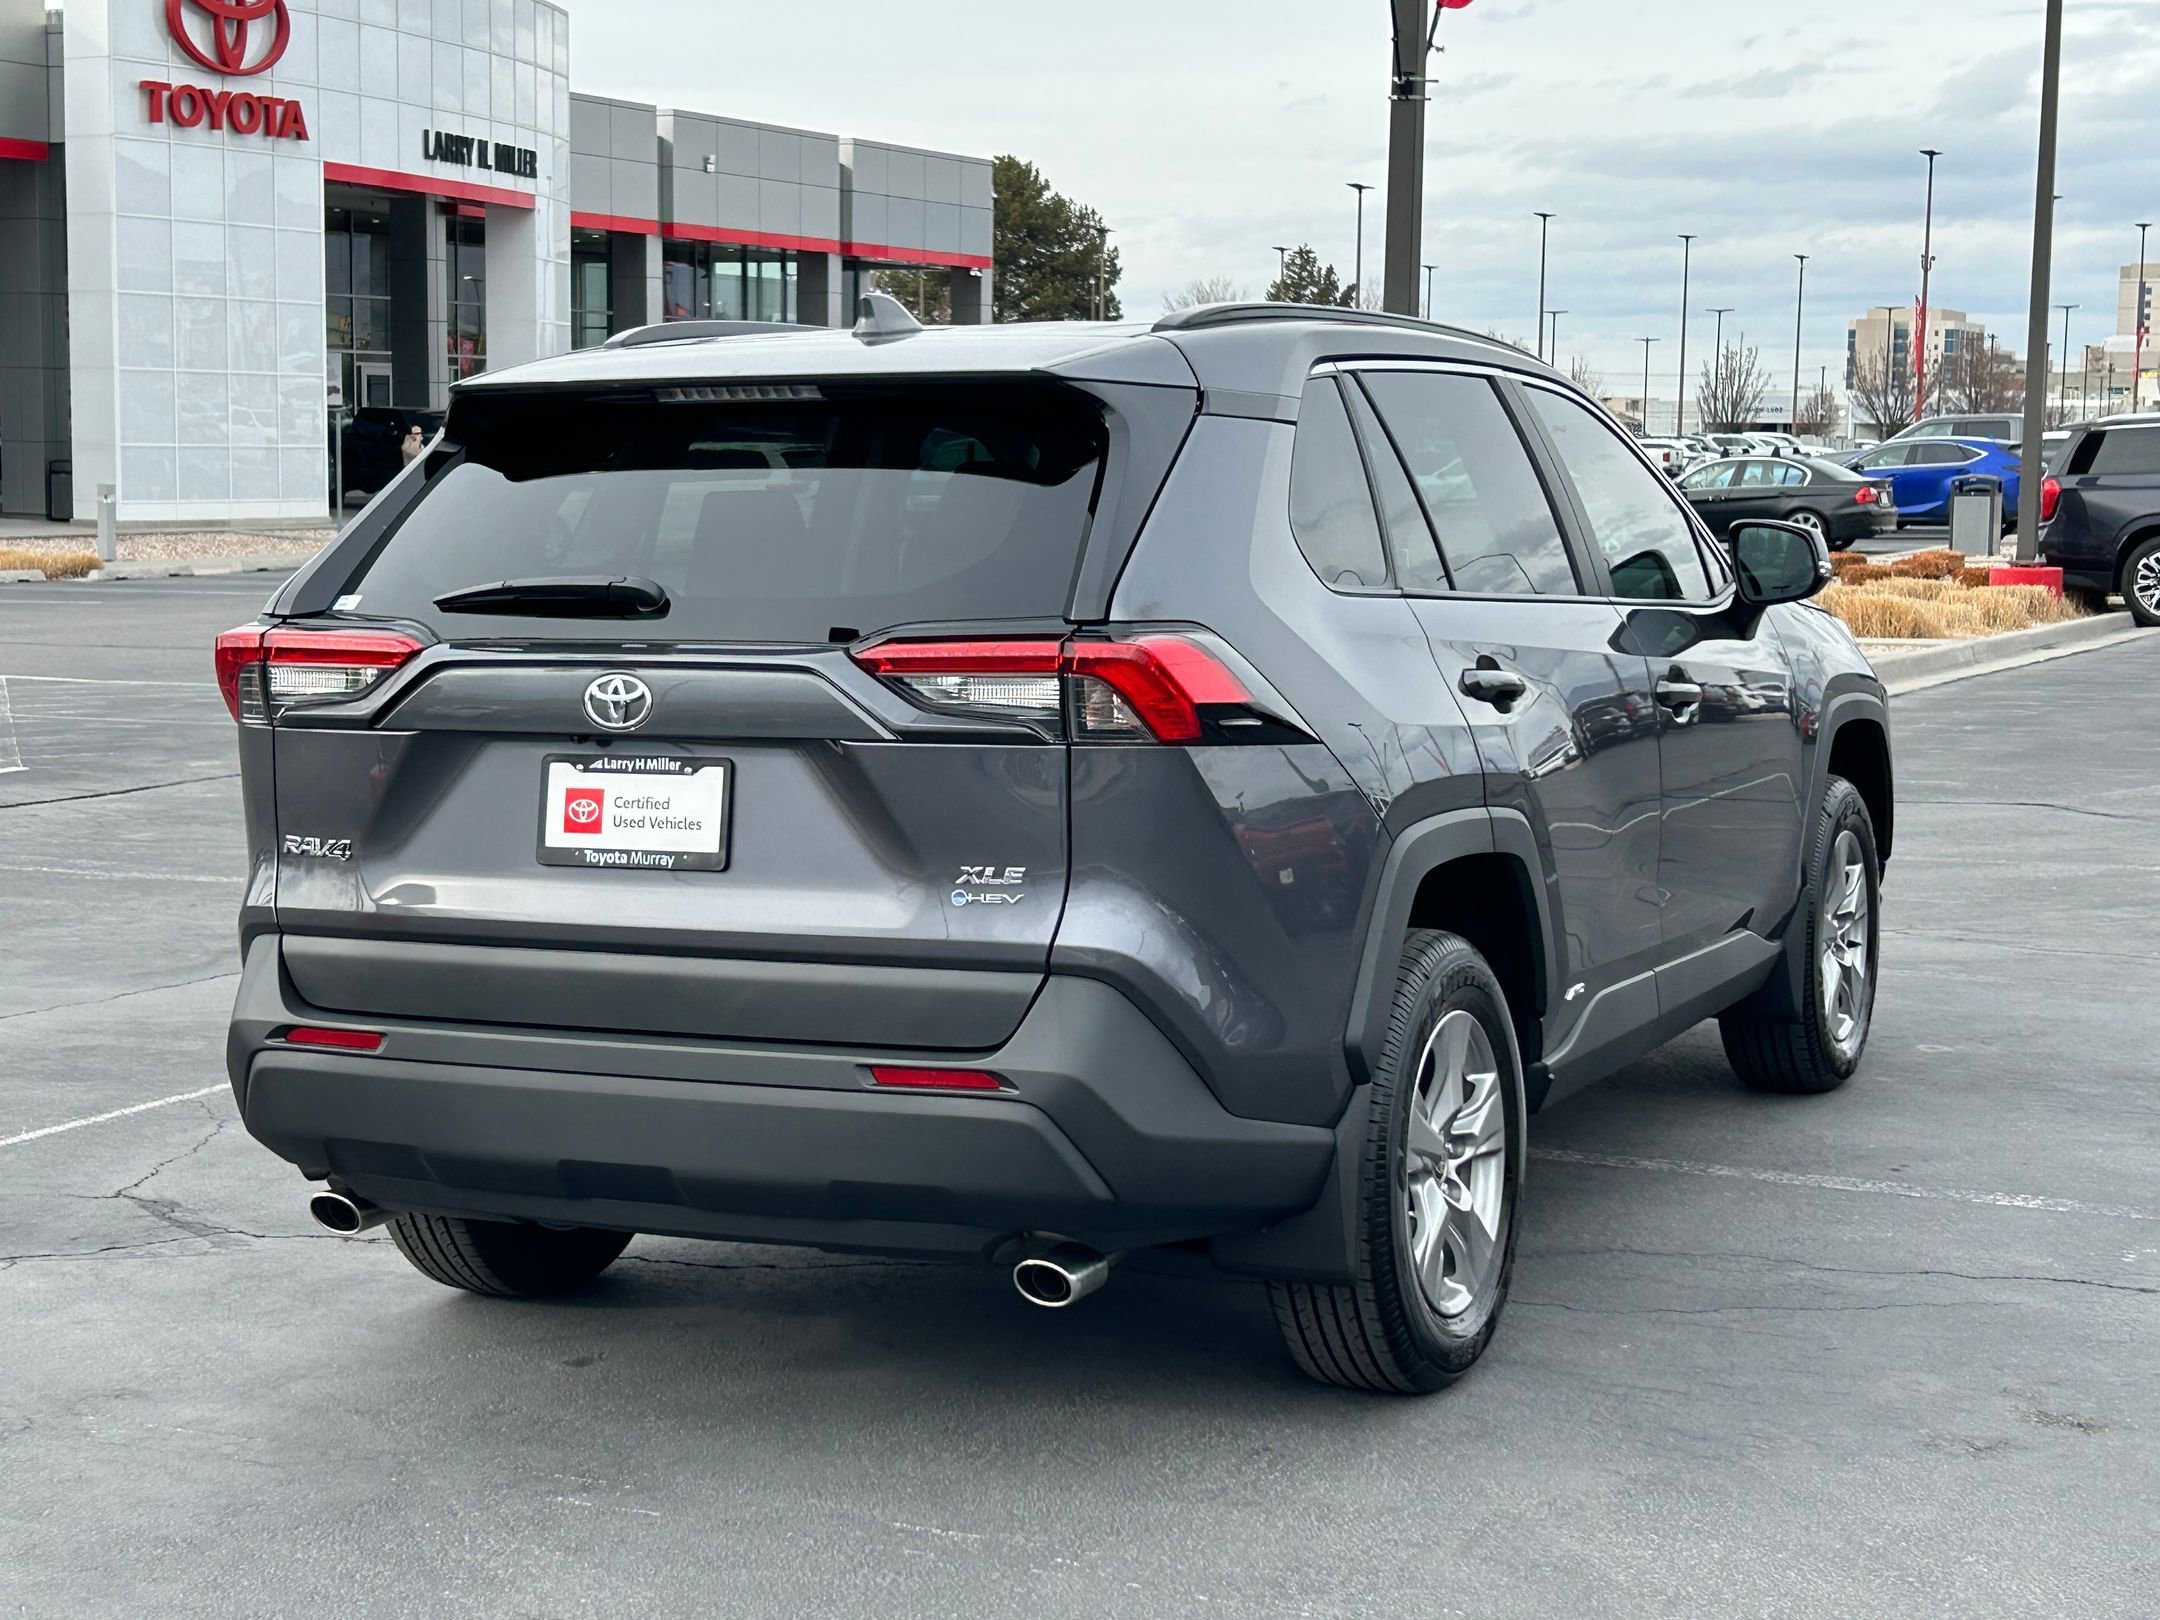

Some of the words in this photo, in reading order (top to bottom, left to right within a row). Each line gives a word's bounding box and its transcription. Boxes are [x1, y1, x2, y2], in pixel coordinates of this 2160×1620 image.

[139, 80, 310, 141] TOYOTA
[423, 129, 475, 167] LARRY
[494, 142, 538, 179] MILLER
[604, 757, 634, 772] Larry
[635, 758, 645, 771] H
[646, 757, 681, 772] Miller
[614, 796, 671, 810] Certified
[613, 815, 646, 829] Used
[649, 816, 702, 831] Vehicles
[283, 834, 352, 860] RAV4
[584, 849, 628, 866] Toyota
[629, 851, 676, 869] Murray
[955, 866, 1026, 885] XLE
